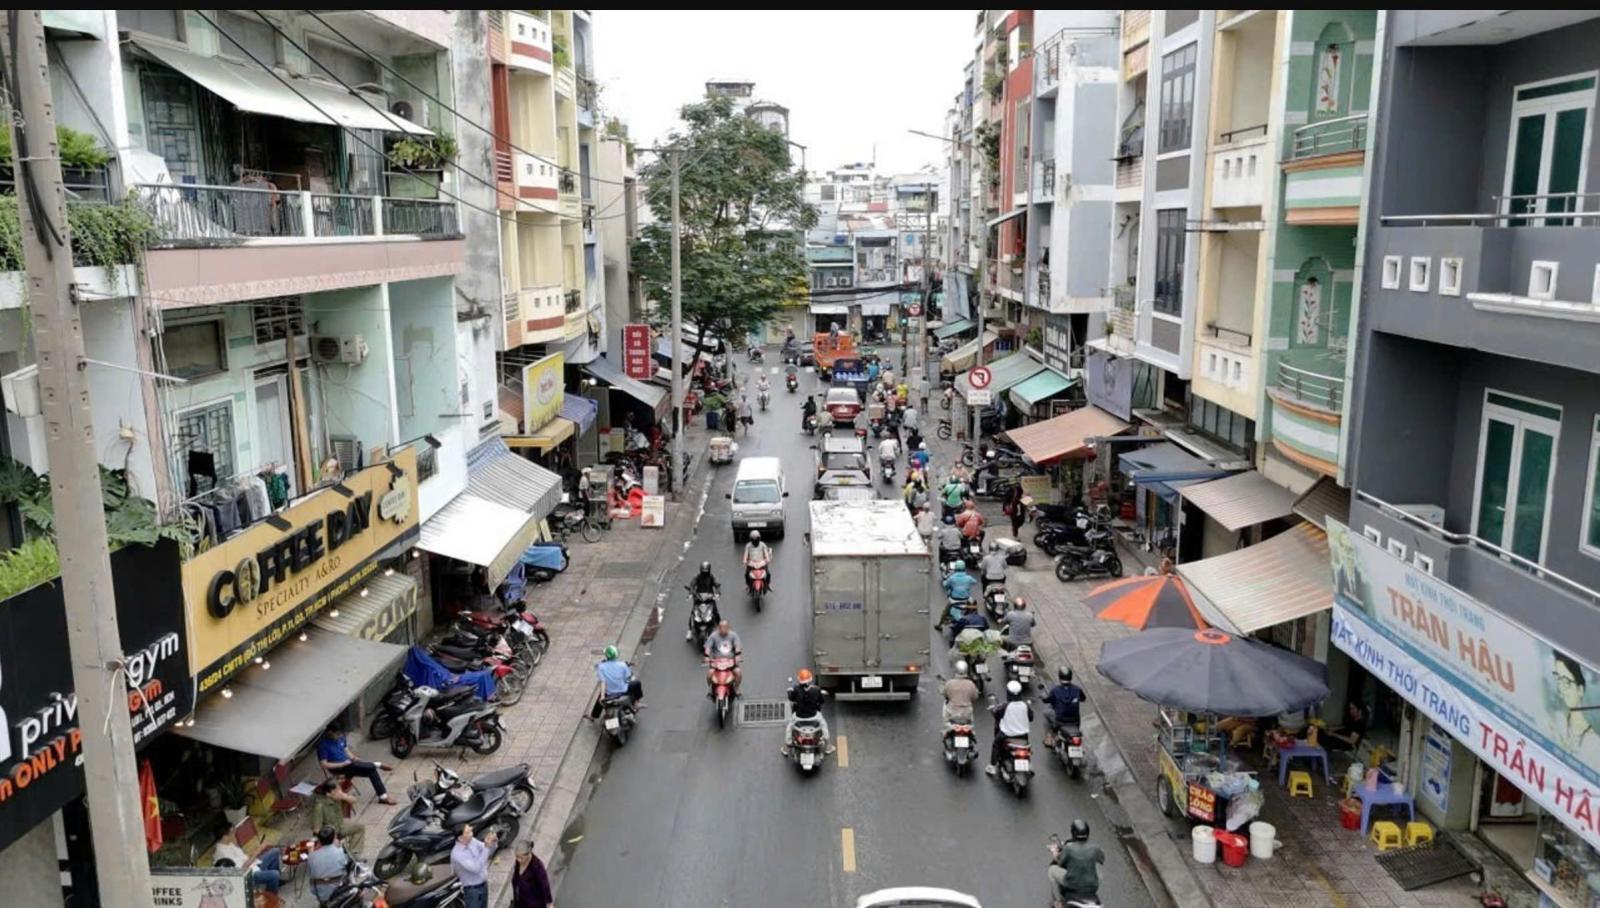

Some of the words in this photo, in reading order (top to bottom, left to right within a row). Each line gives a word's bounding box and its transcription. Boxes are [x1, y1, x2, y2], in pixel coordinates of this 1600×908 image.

[206, 519, 325, 619] COFFEE
[326, 490, 373, 551] DAY
[256, 574, 311, 620] SPECIALTY
[10, 736, 66, 788] ONLY
[1422, 684, 1470, 737] TRANG
[1554, 776, 1600, 837] HẬ
[152, 887, 182, 897] FFEE
